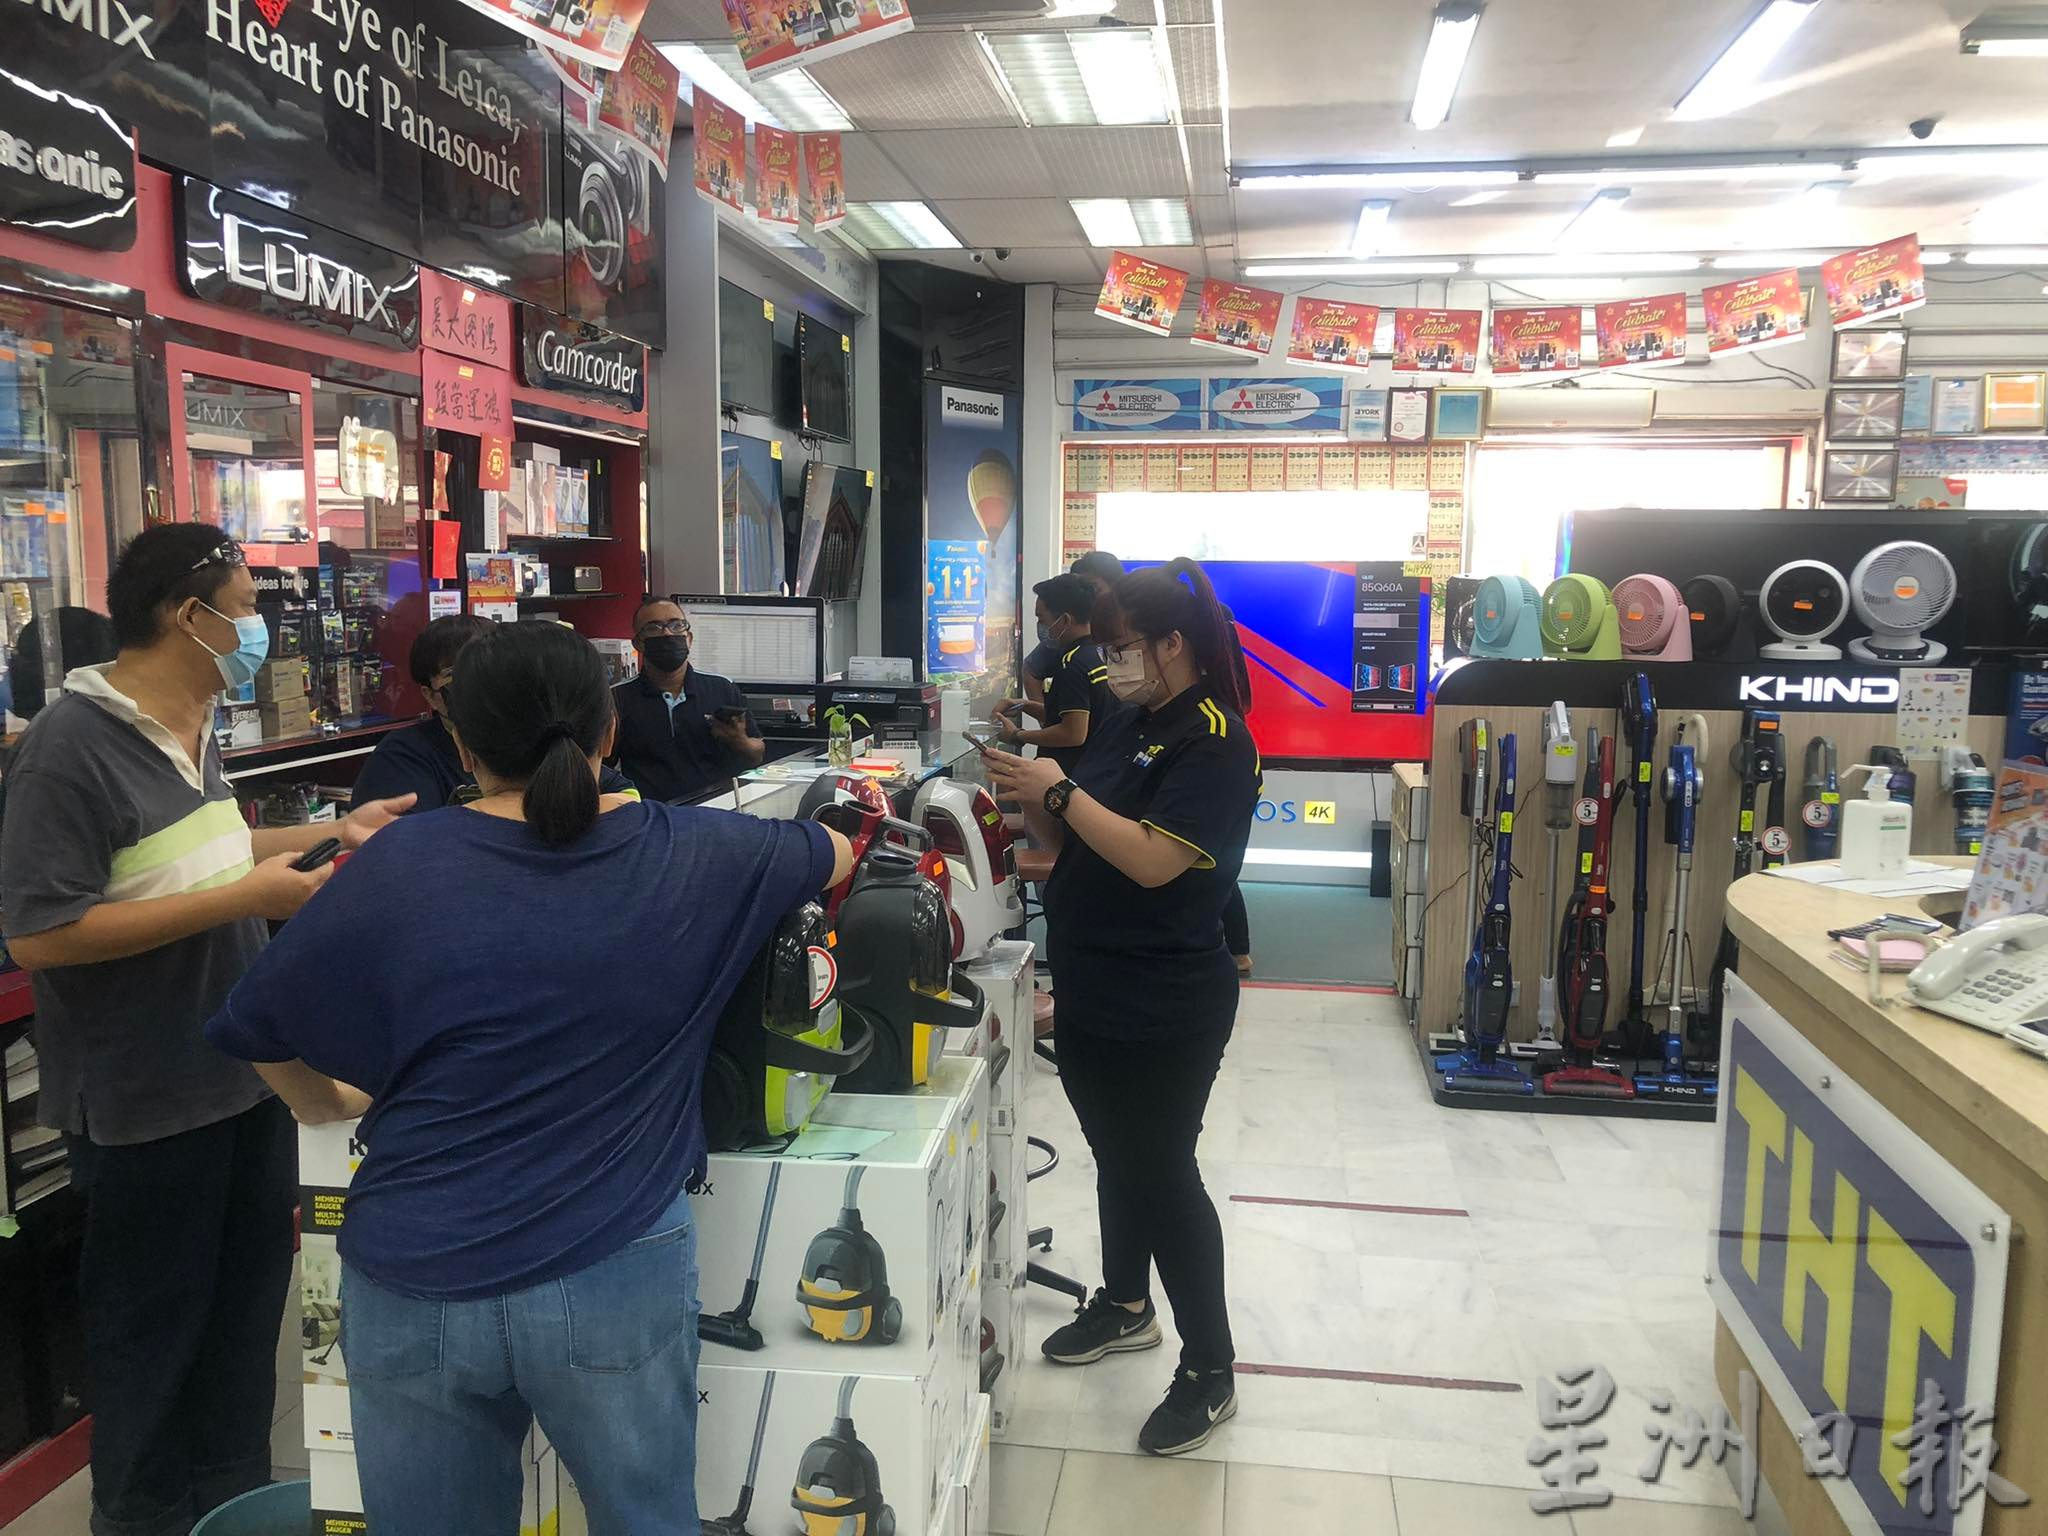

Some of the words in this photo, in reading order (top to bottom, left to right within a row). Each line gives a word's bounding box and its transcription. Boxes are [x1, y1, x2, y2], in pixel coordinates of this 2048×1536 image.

[391, 23, 426, 80] of
[434, 36, 523, 144] Leica,
[206, 0, 323, 94] Heart
[333, 64, 370, 118] of
[379, 75, 521, 197] Panasonic
[223, 213, 394, 329] LUMIX
[538, 329, 638, 394] Camcorder
[1119, 395, 1163, 403] MITSUBISHI
[1255, 392, 1302, 401] MITSUBISHI
[946, 396, 1000, 417] Panasonic
[1119, 402, 1156, 411] ELECTRIC
[1255, 400, 1295, 409] ELECTRIC
[185, 399, 246, 428] UMIX
[1360, 408, 1380, 416] YORK
[1361, 582, 1403, 593] 85Q60A
[1739, 675, 1900, 703] KHIND
[1254, 799, 1297, 823] OS
[1308, 806, 1330, 819] 4K
[1583, 804, 1591, 817] 5
[1814, 806, 1822, 819] 5
[1772, 833, 1780, 847] 5
[1663, 1086, 1697, 1095] KHIND
[314, 1195, 346, 1204] MEHRZW
[314, 1202, 342, 1210] SAUGER
[314, 1211, 345, 1220] MULTI-P
[1735, 1063, 1956, 1507] THT
